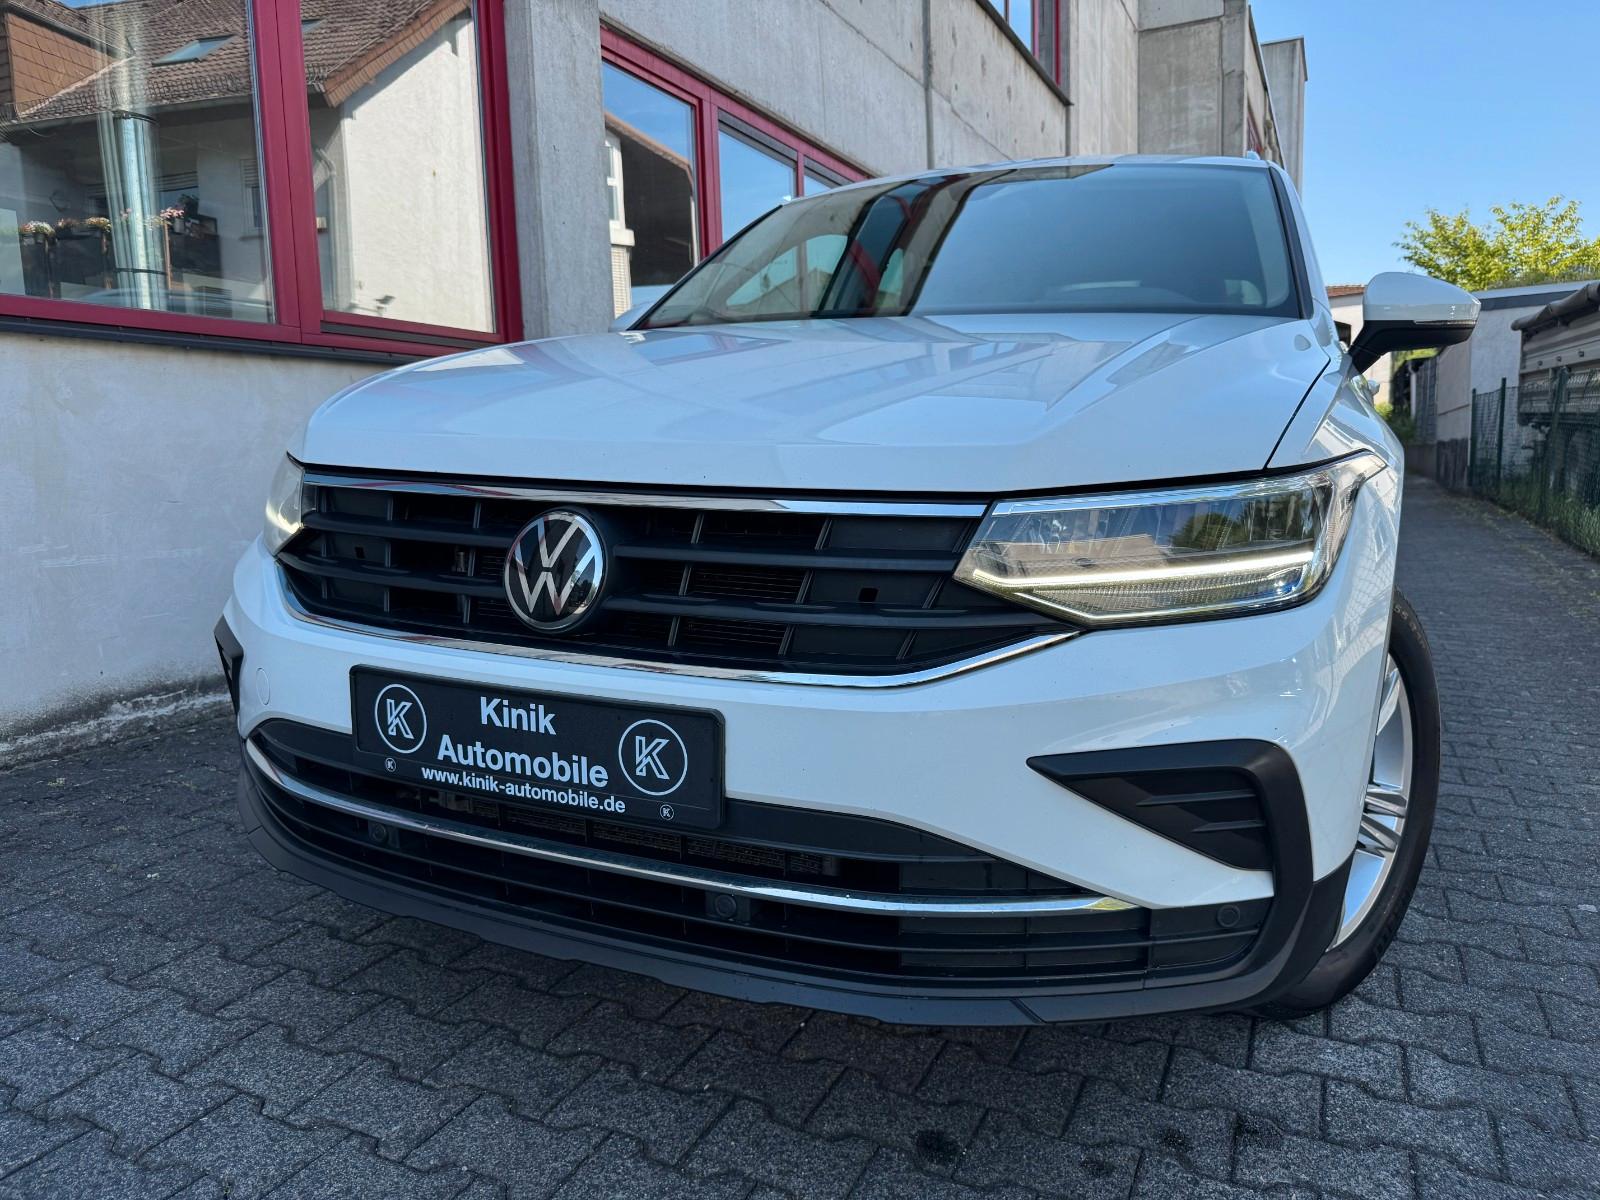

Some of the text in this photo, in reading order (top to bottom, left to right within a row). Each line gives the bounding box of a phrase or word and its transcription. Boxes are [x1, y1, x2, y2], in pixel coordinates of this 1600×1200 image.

[514, 516, 601, 616] VW
[386, 698, 415, 740] K
[480, 696, 557, 736] Kinik
[437, 734, 609, 788] Automobile
[636, 735, 670, 780] K
[421, 766, 626, 813] www.kinik-automobile.de
